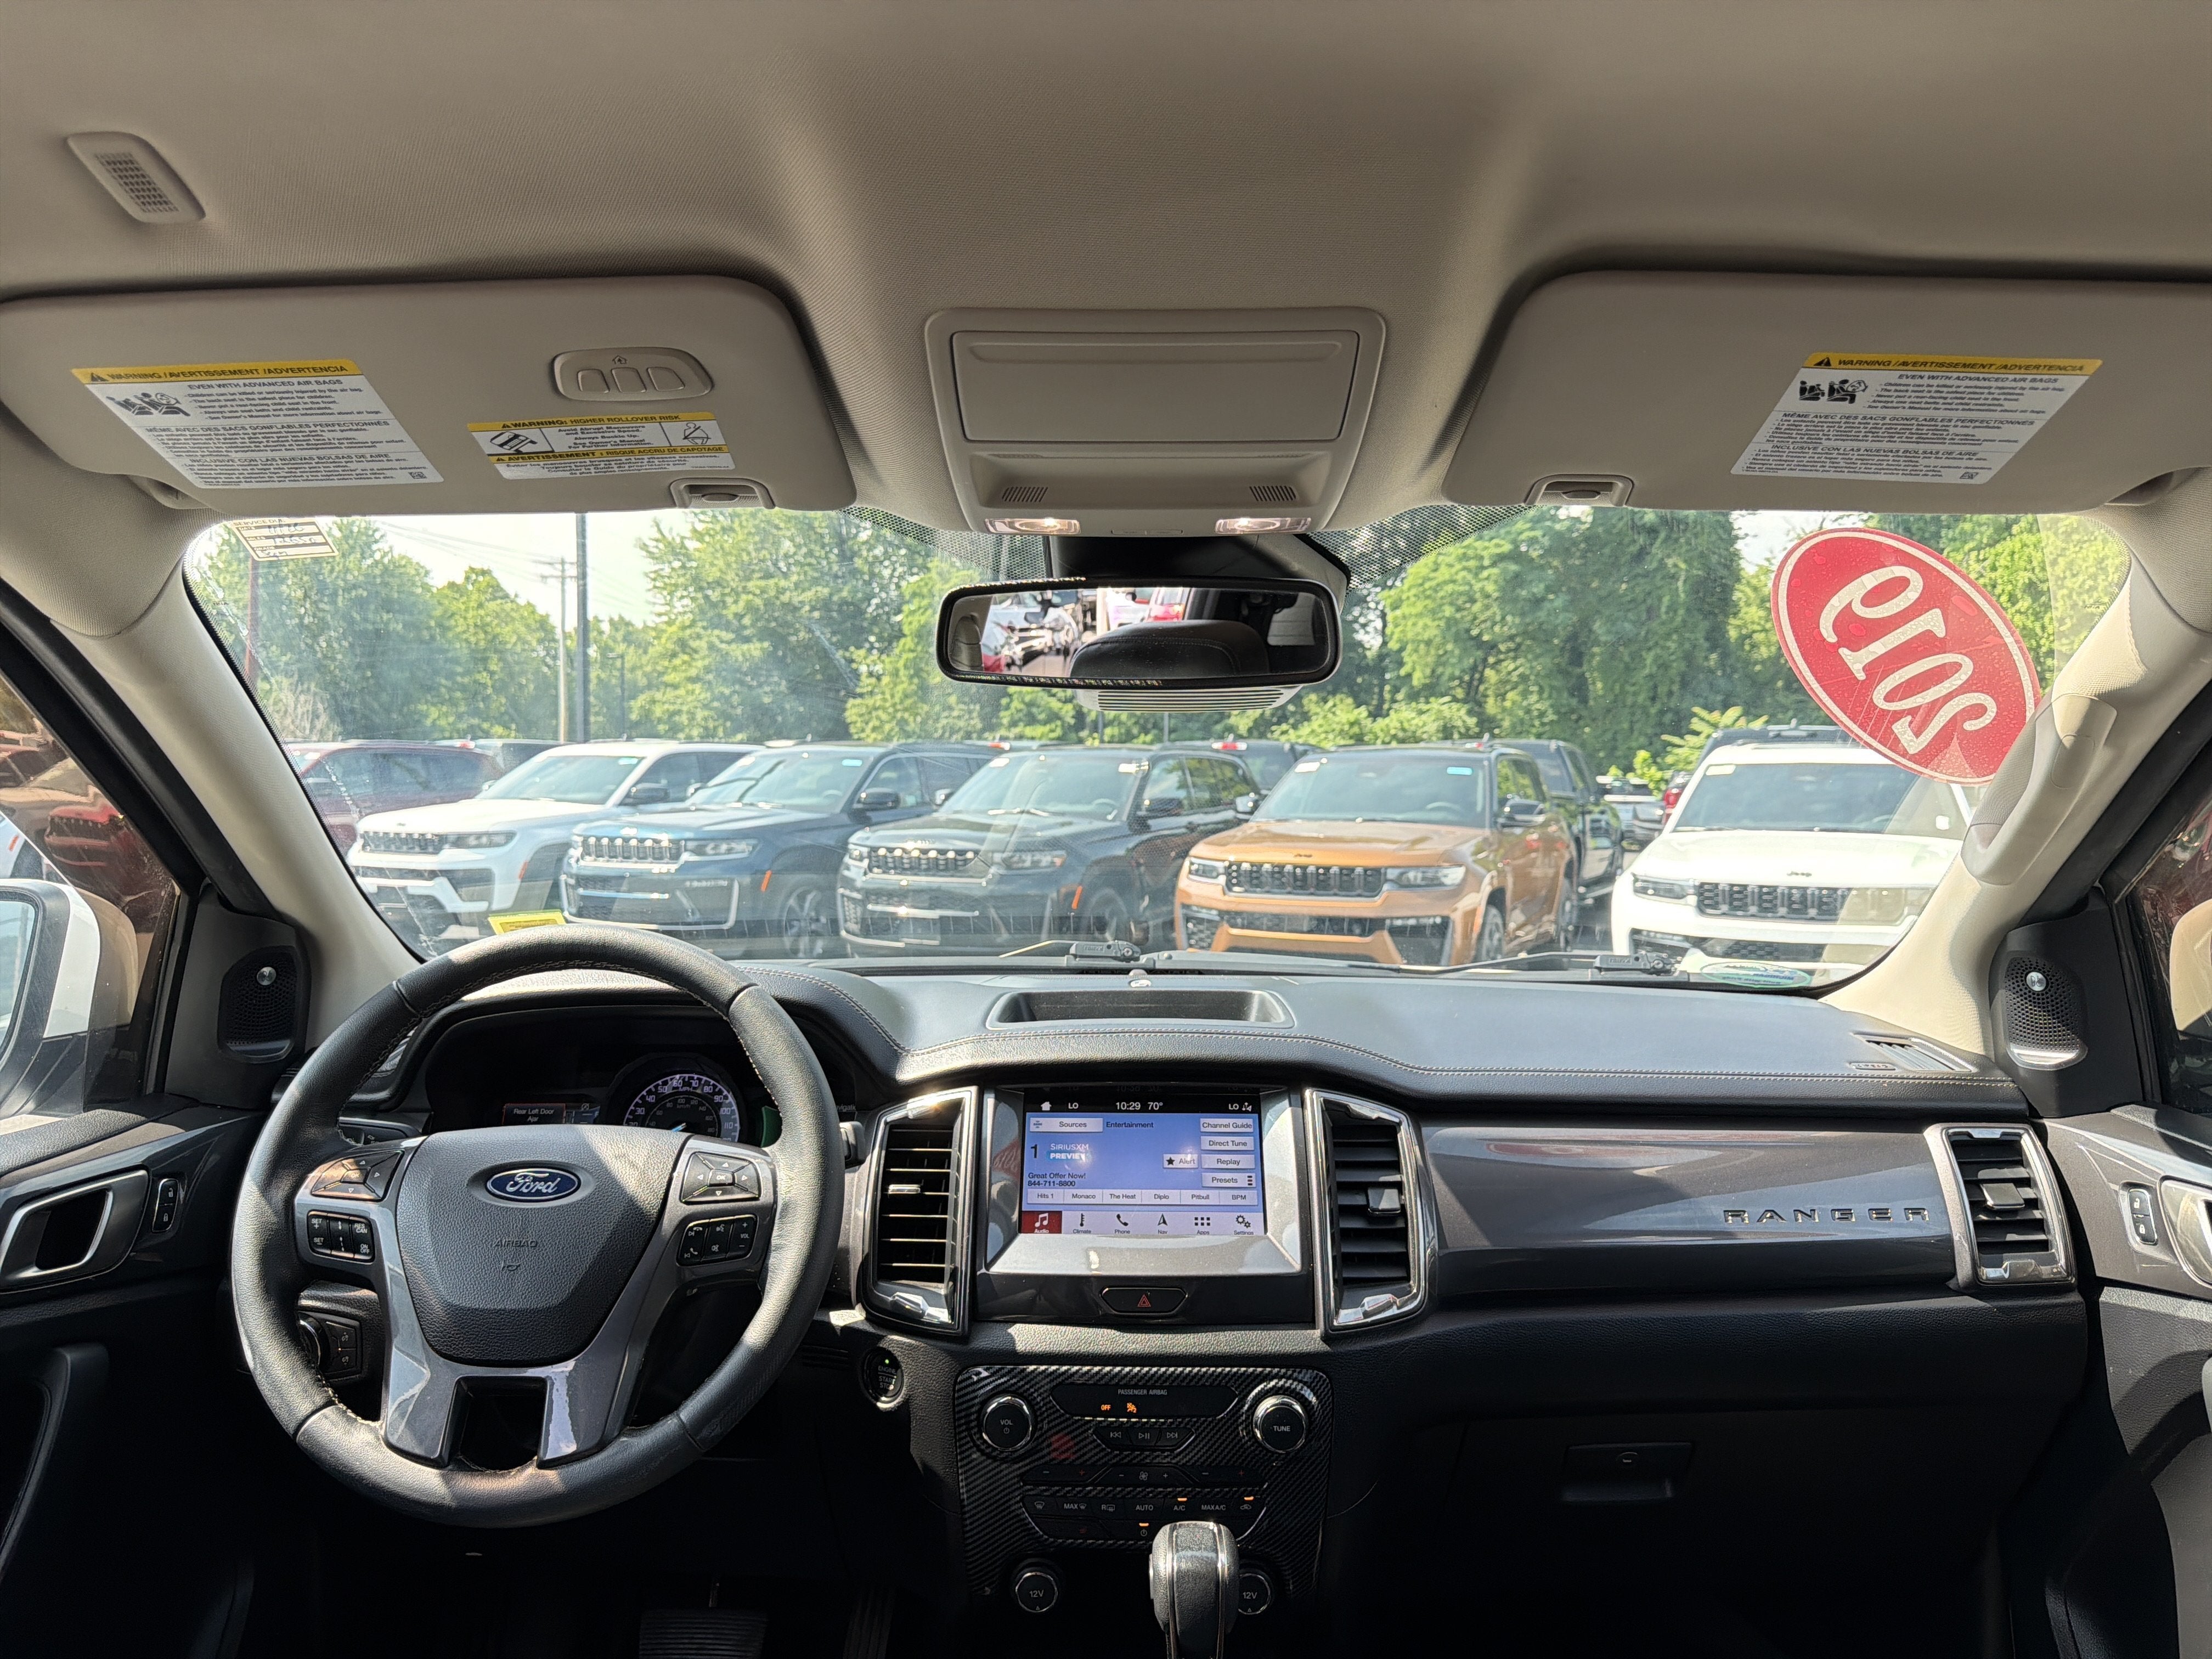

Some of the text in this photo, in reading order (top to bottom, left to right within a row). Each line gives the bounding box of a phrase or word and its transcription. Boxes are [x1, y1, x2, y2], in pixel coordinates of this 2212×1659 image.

[511, 420, 568, 428] WARNING:
[507, 452, 596, 461] AVERTISSEMENT
[1115, 1102, 1141, 1110] 10:29
[1031, 1144, 1038, 1159] 1
[506, 1172, 561, 1193] Ford
[1723, 1207, 1931, 1224] RANGER
[879, 1376, 895, 1385] START
[1243, 1591, 1258, 1599] 12V
